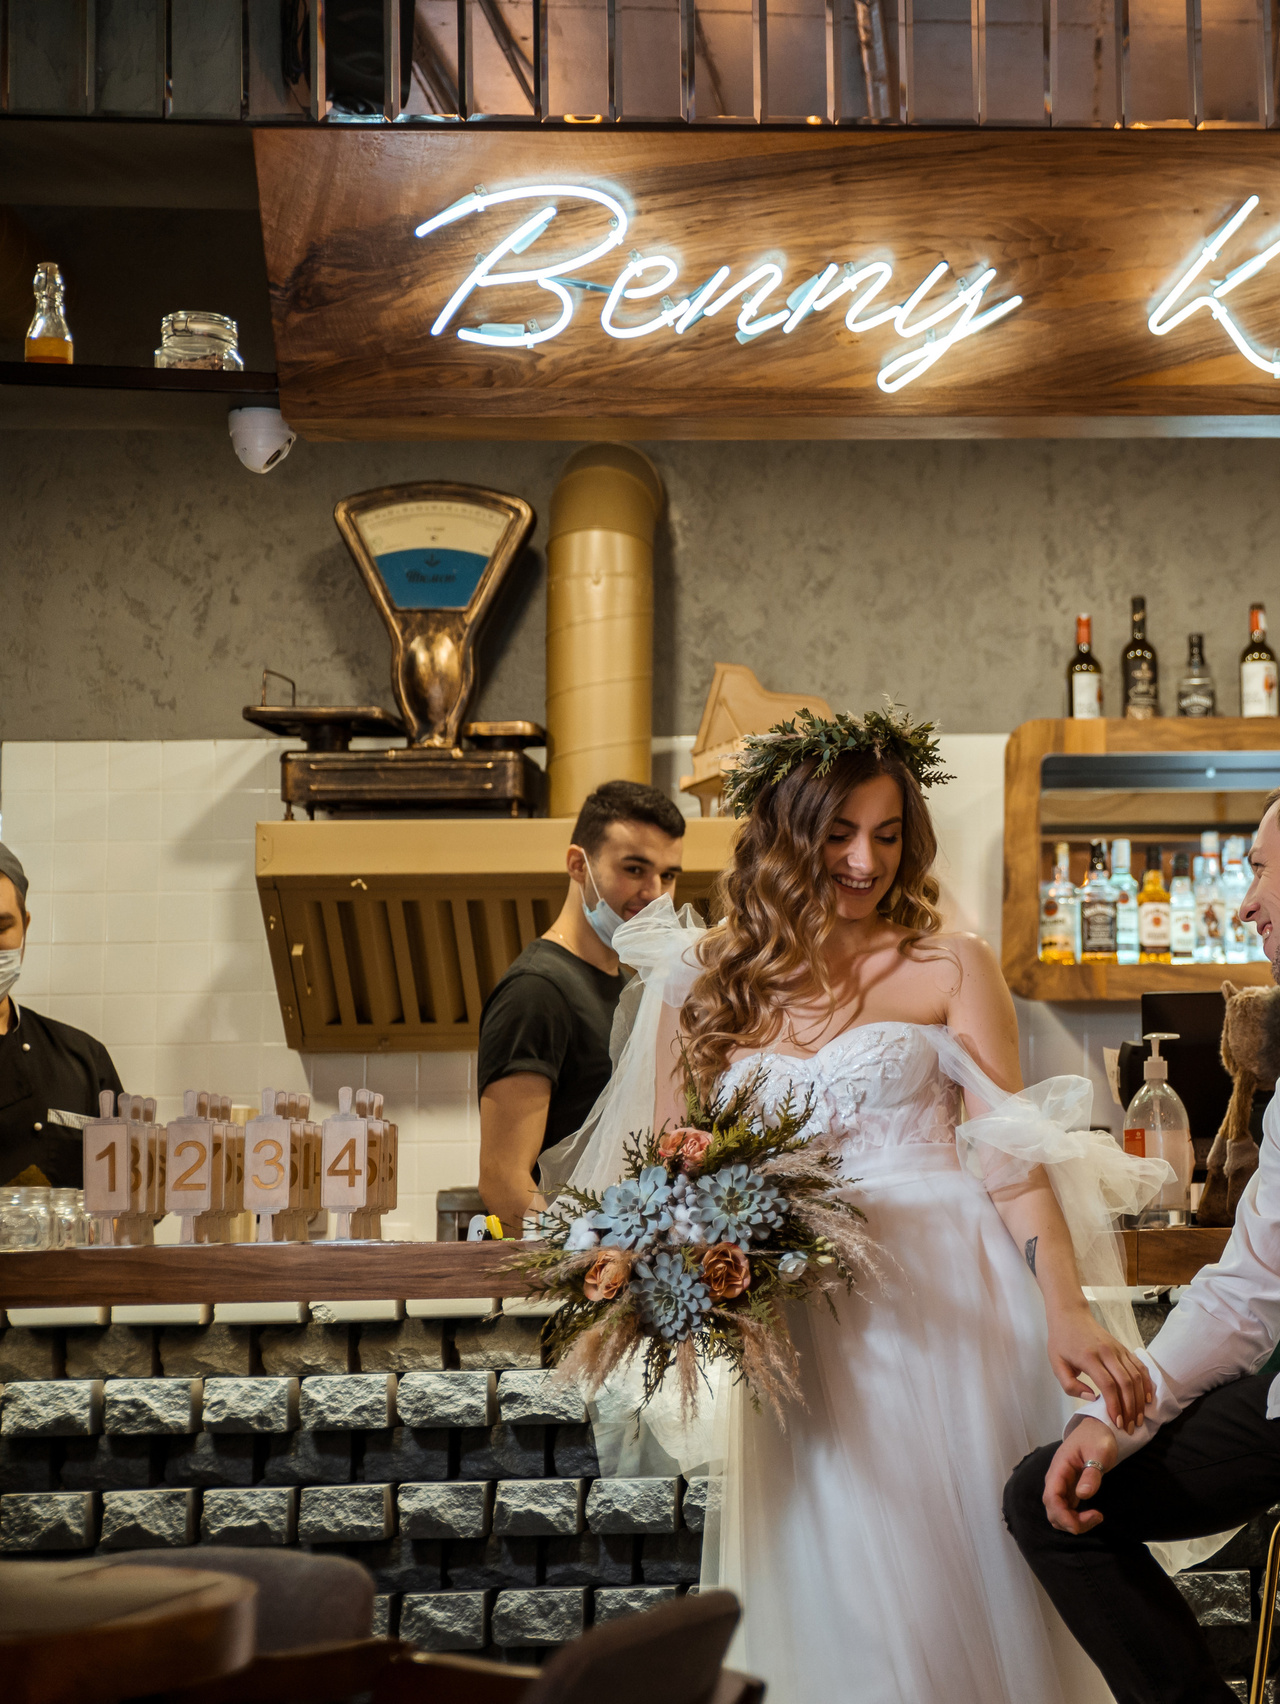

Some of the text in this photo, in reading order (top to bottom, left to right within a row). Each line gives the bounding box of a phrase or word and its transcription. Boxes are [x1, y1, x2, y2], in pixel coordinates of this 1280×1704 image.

[414, 183, 1023, 393] Benny
[95, 1141, 116, 1193] 1
[171, 1140, 207, 1192] 2
[251, 1138, 285, 1190] 3
[326, 1137, 362, 1188] 4
